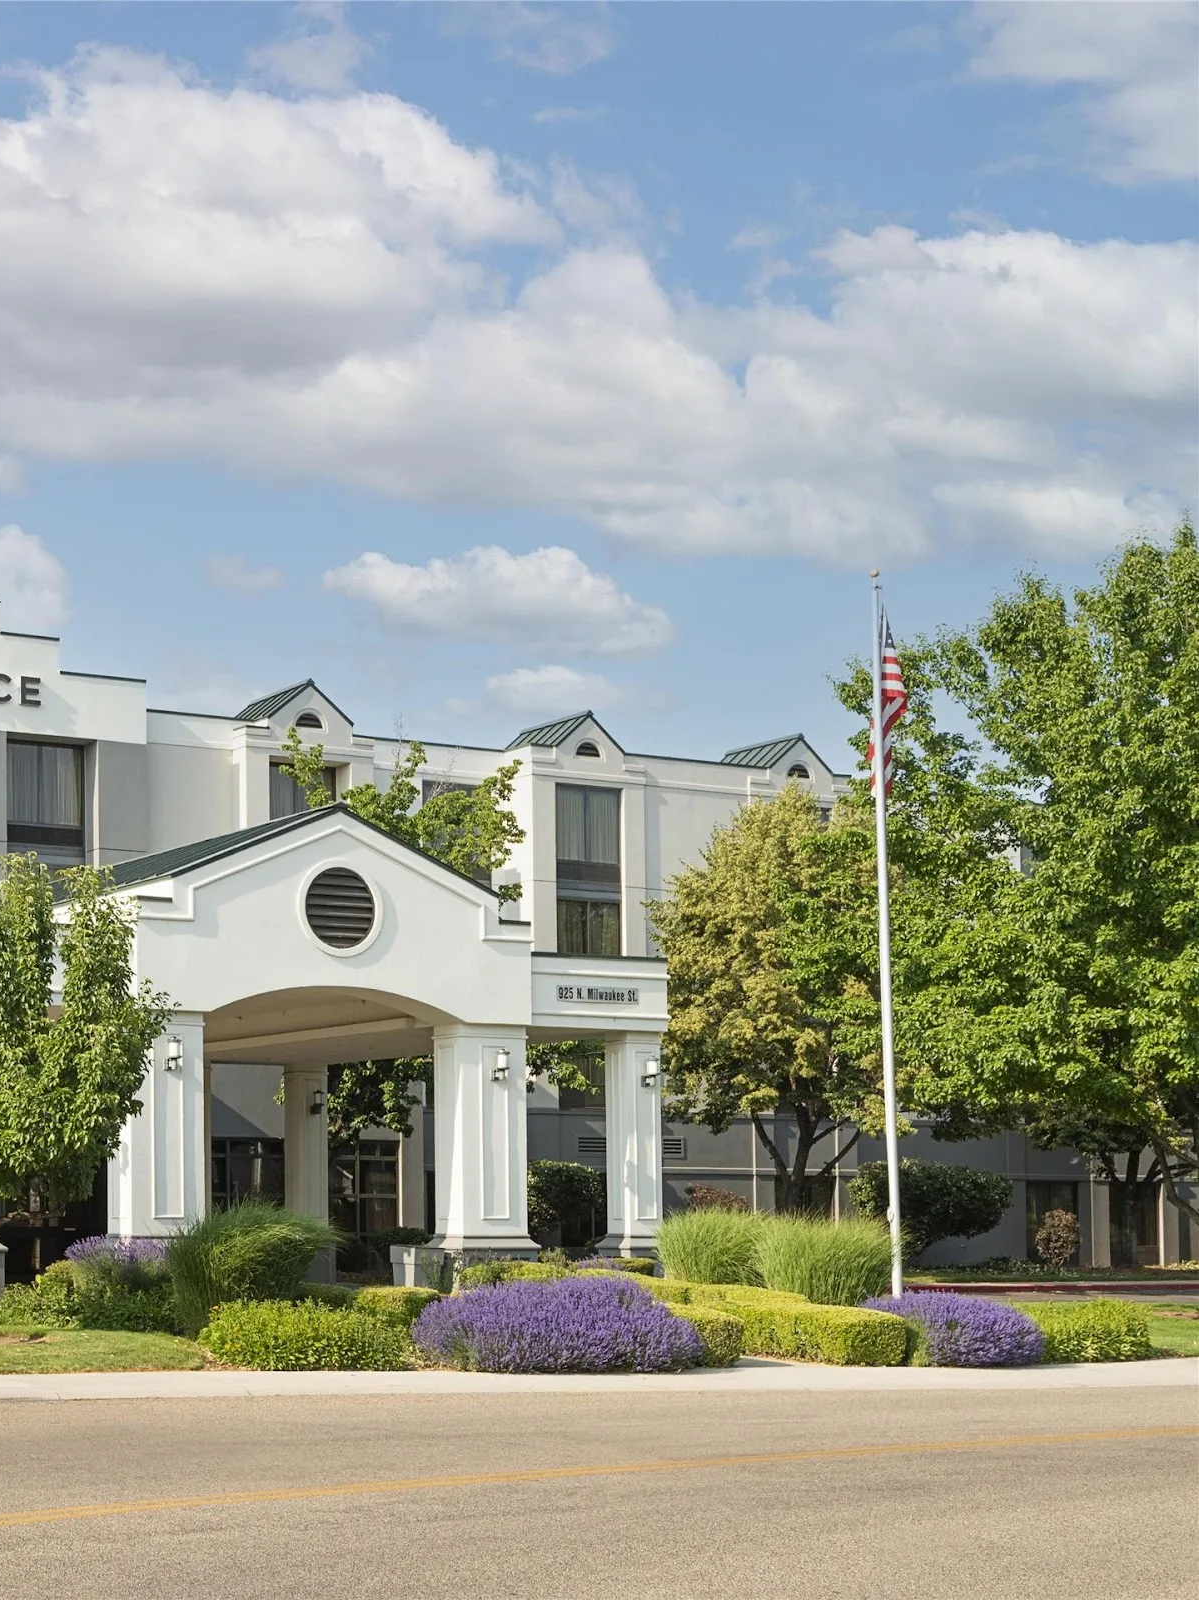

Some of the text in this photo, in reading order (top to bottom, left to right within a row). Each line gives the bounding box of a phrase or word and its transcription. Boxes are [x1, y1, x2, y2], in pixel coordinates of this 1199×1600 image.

[558, 987, 638, 1002] 925 N. Milwaukee St.
